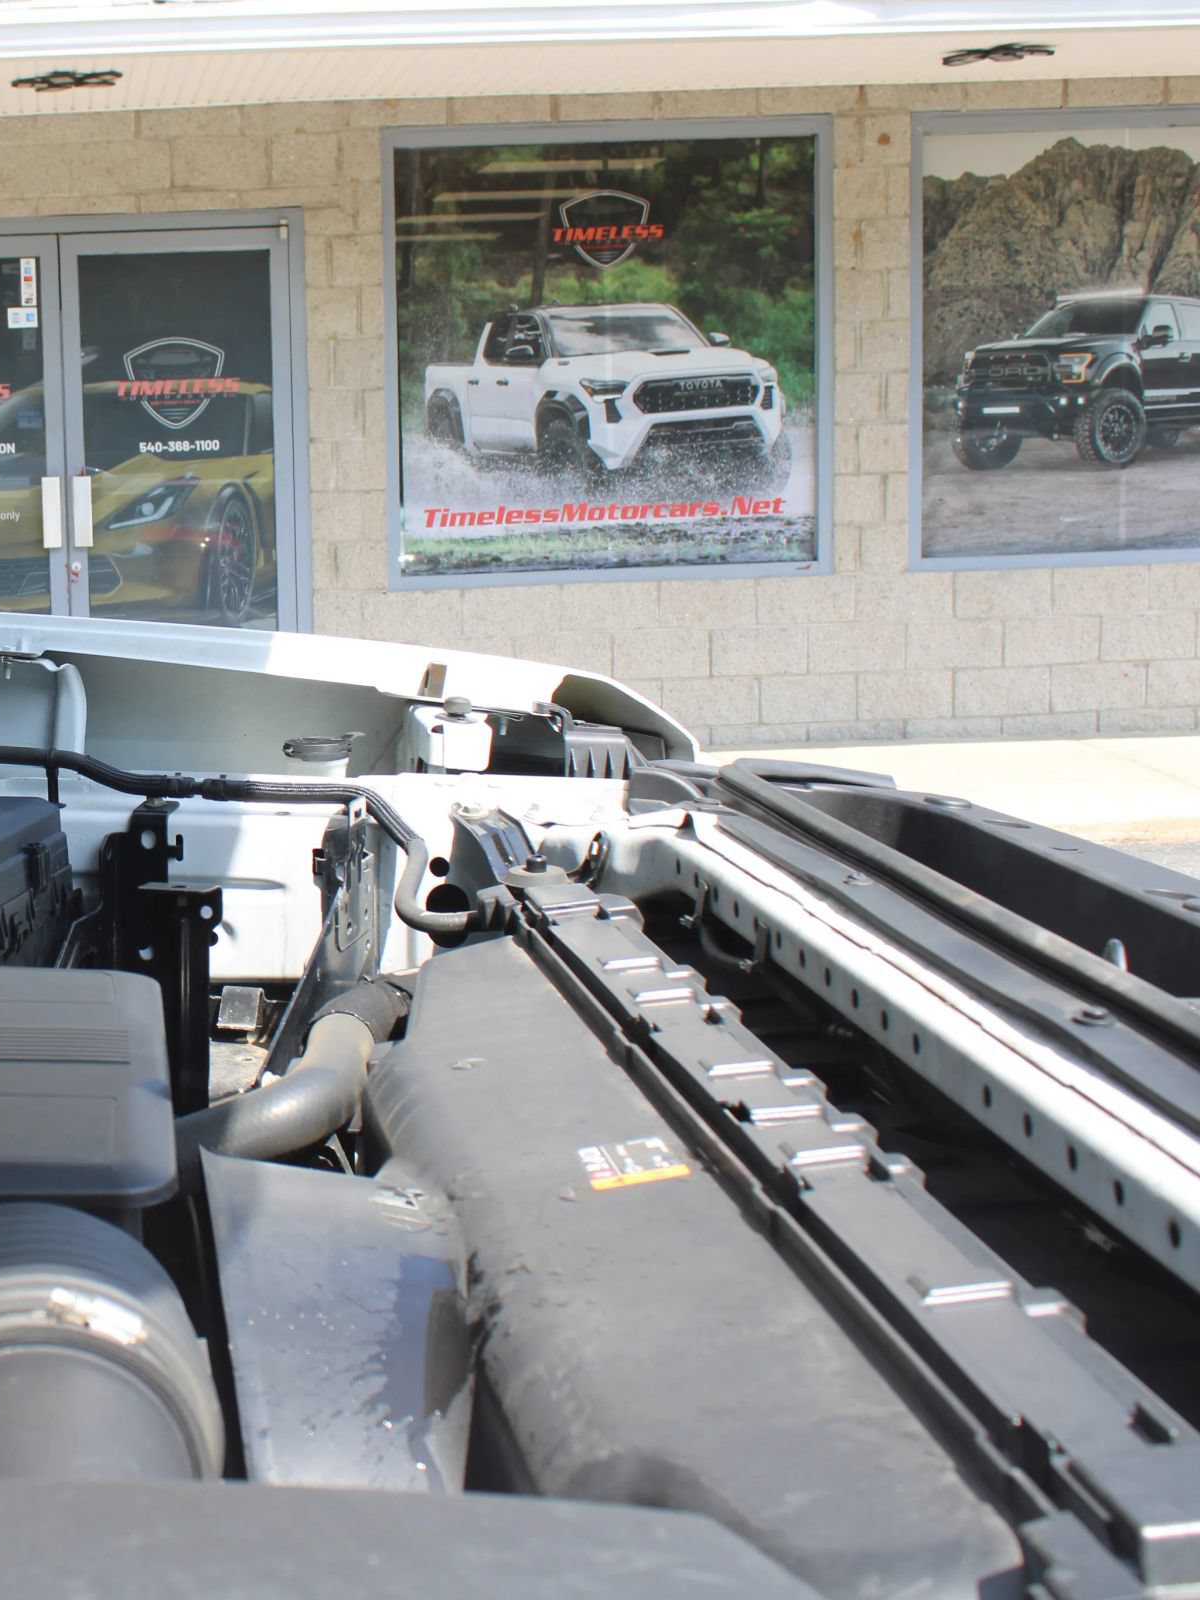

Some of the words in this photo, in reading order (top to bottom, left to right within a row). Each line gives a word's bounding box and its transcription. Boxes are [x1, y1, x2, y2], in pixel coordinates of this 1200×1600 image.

[552, 224, 665, 242] TIMELESS
[116, 378, 241, 397] TIMELESS
[680, 380, 723, 391] TOYOTA
[0, 511, 21, 522] only
[424, 495, 787, 529] TimelessMotorcars.Net
